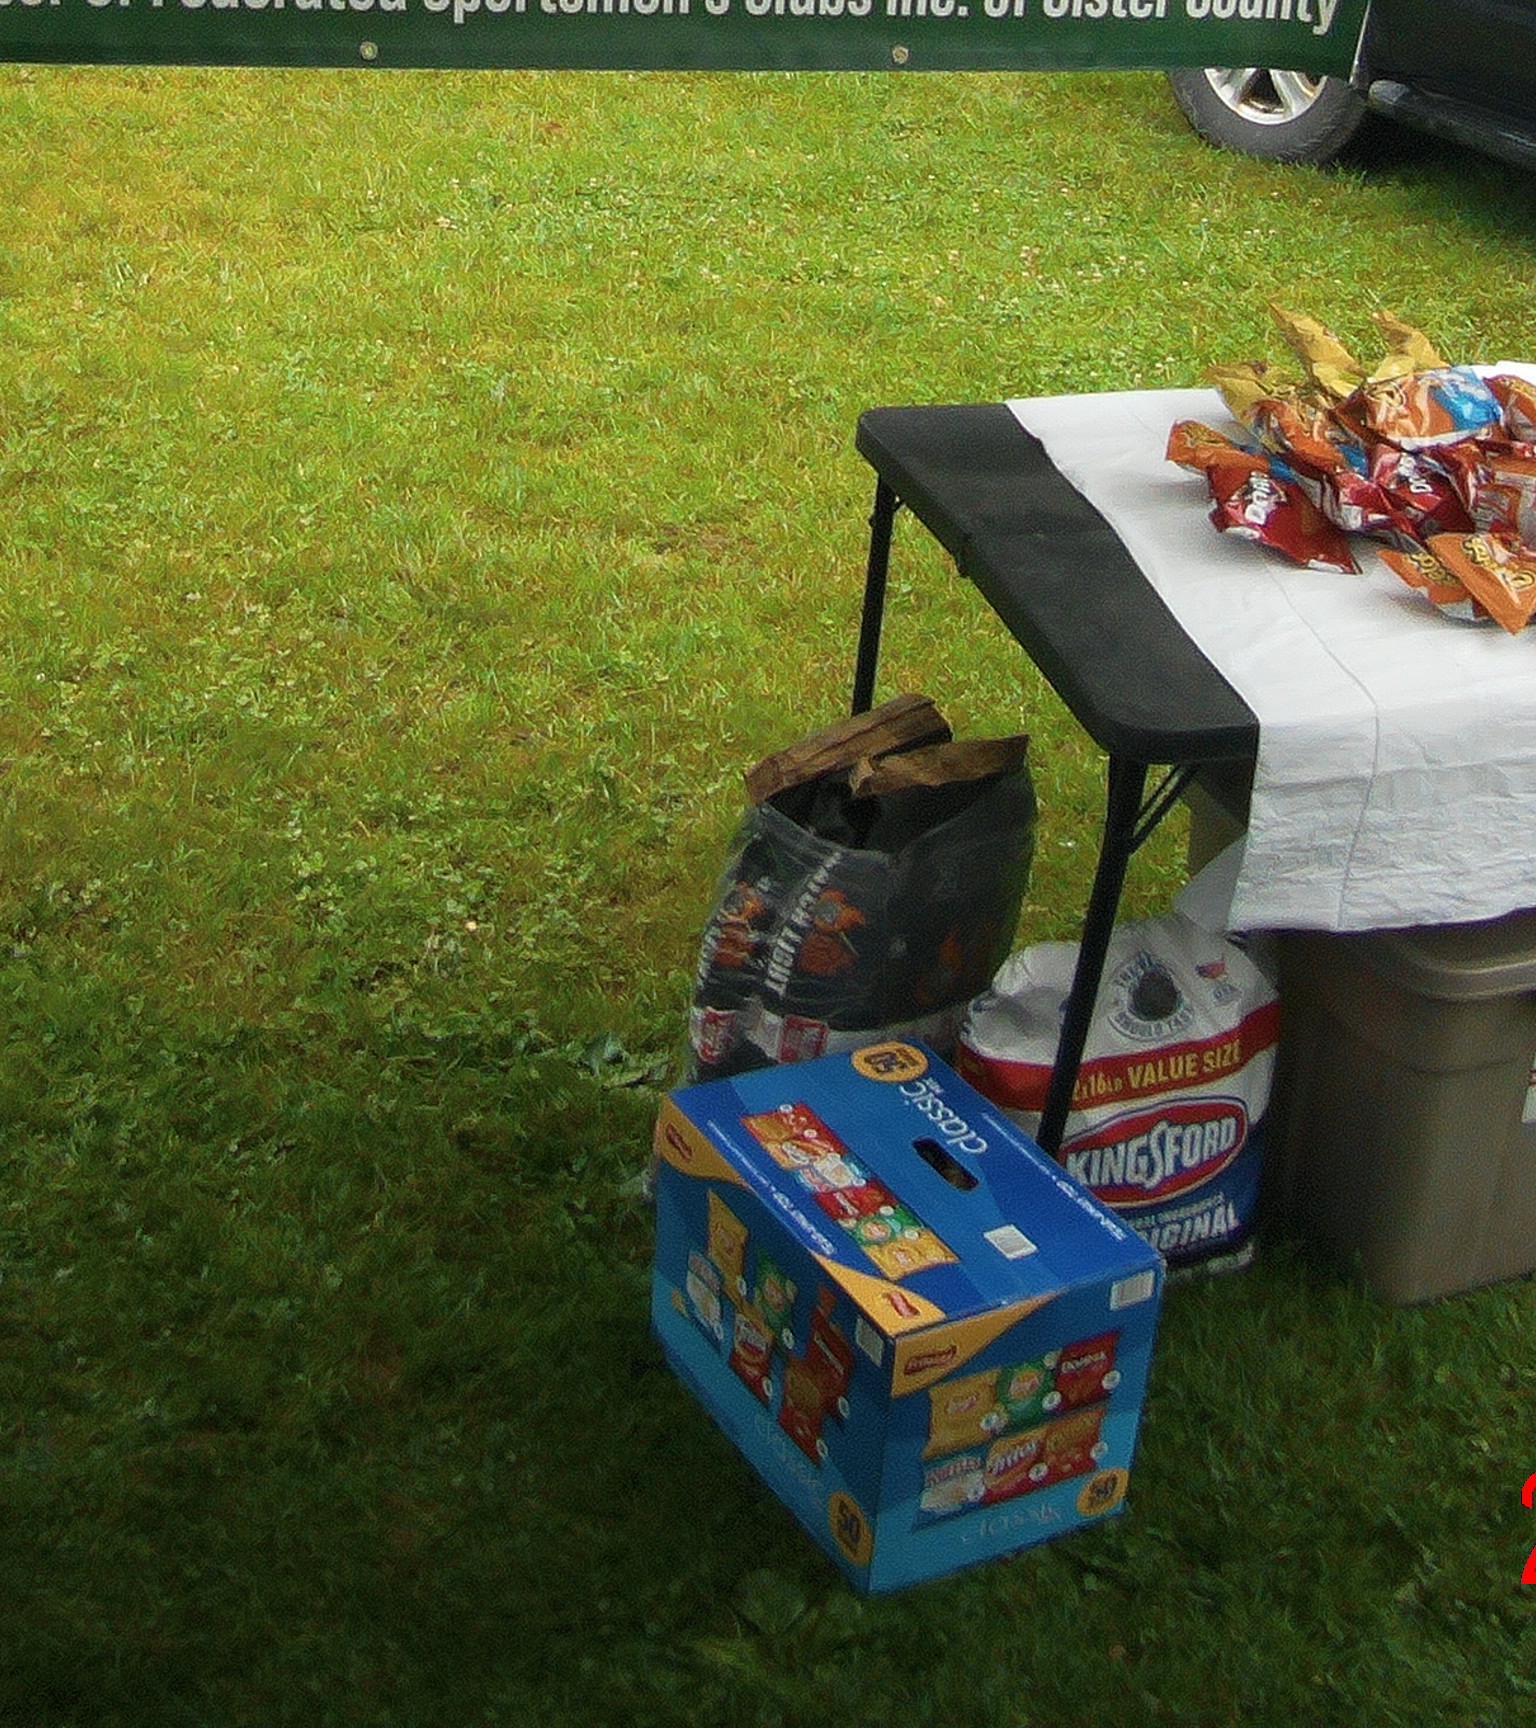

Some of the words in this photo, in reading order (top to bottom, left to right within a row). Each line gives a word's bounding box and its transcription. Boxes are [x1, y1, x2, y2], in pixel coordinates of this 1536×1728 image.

[1127, 1051, 1198, 1090] VALUE
[1202, 1038, 1242, 1072] SIZE
[900, 1076, 989, 1157] classic
[1064, 1115, 1239, 1191] KINGSFORD
